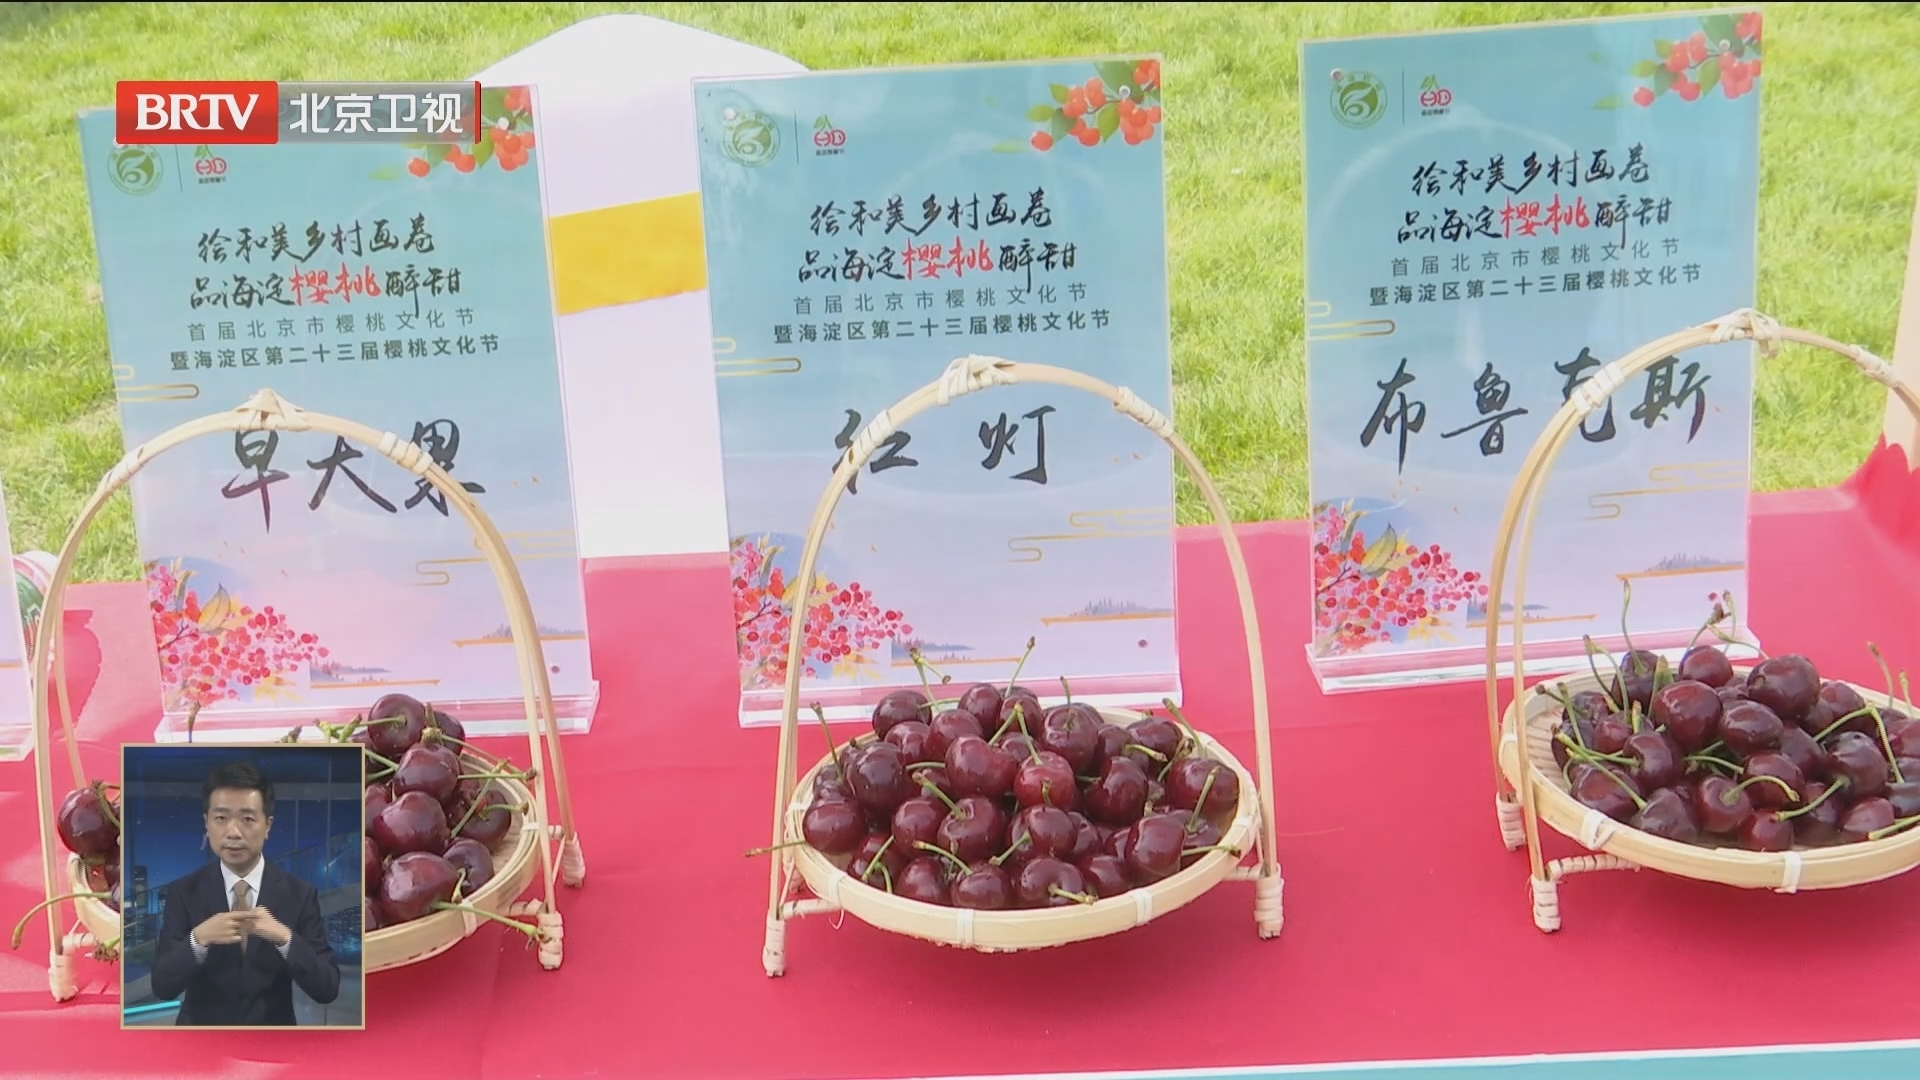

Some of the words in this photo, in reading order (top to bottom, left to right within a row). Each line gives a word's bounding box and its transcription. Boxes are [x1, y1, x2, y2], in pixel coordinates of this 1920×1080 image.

[1412, 142, 1650, 197] 绘和美乡村画卷
[810, 186, 1052, 236] 绘和美乡村画卷
[1397, 194, 1673, 249] 品海淀樱桃醉甜
[198, 213, 435, 263] 绘和美乡村画卷
[1391, 238, 1679, 277] 首届北京市樱桃文化节
[190, 261, 462, 318] 品海淀樱桃醉甜
[799, 236, 1077, 294] 品海淀樱桃醉甜
[1370, 263, 1701, 307] 暨海淀区第二十三届樱桃文化节
[187, 307, 474, 342] 首届北京市樱桃文化节
[793, 283, 1087, 316] 首届北京市樱桃文化节
[170, 333, 500, 371] 暨海淀区第二十三届樱桃文化节
[774, 309, 1111, 345] 暨海淀区第二十三届樱桃文化节
[221, 418, 487, 533] 早大果
